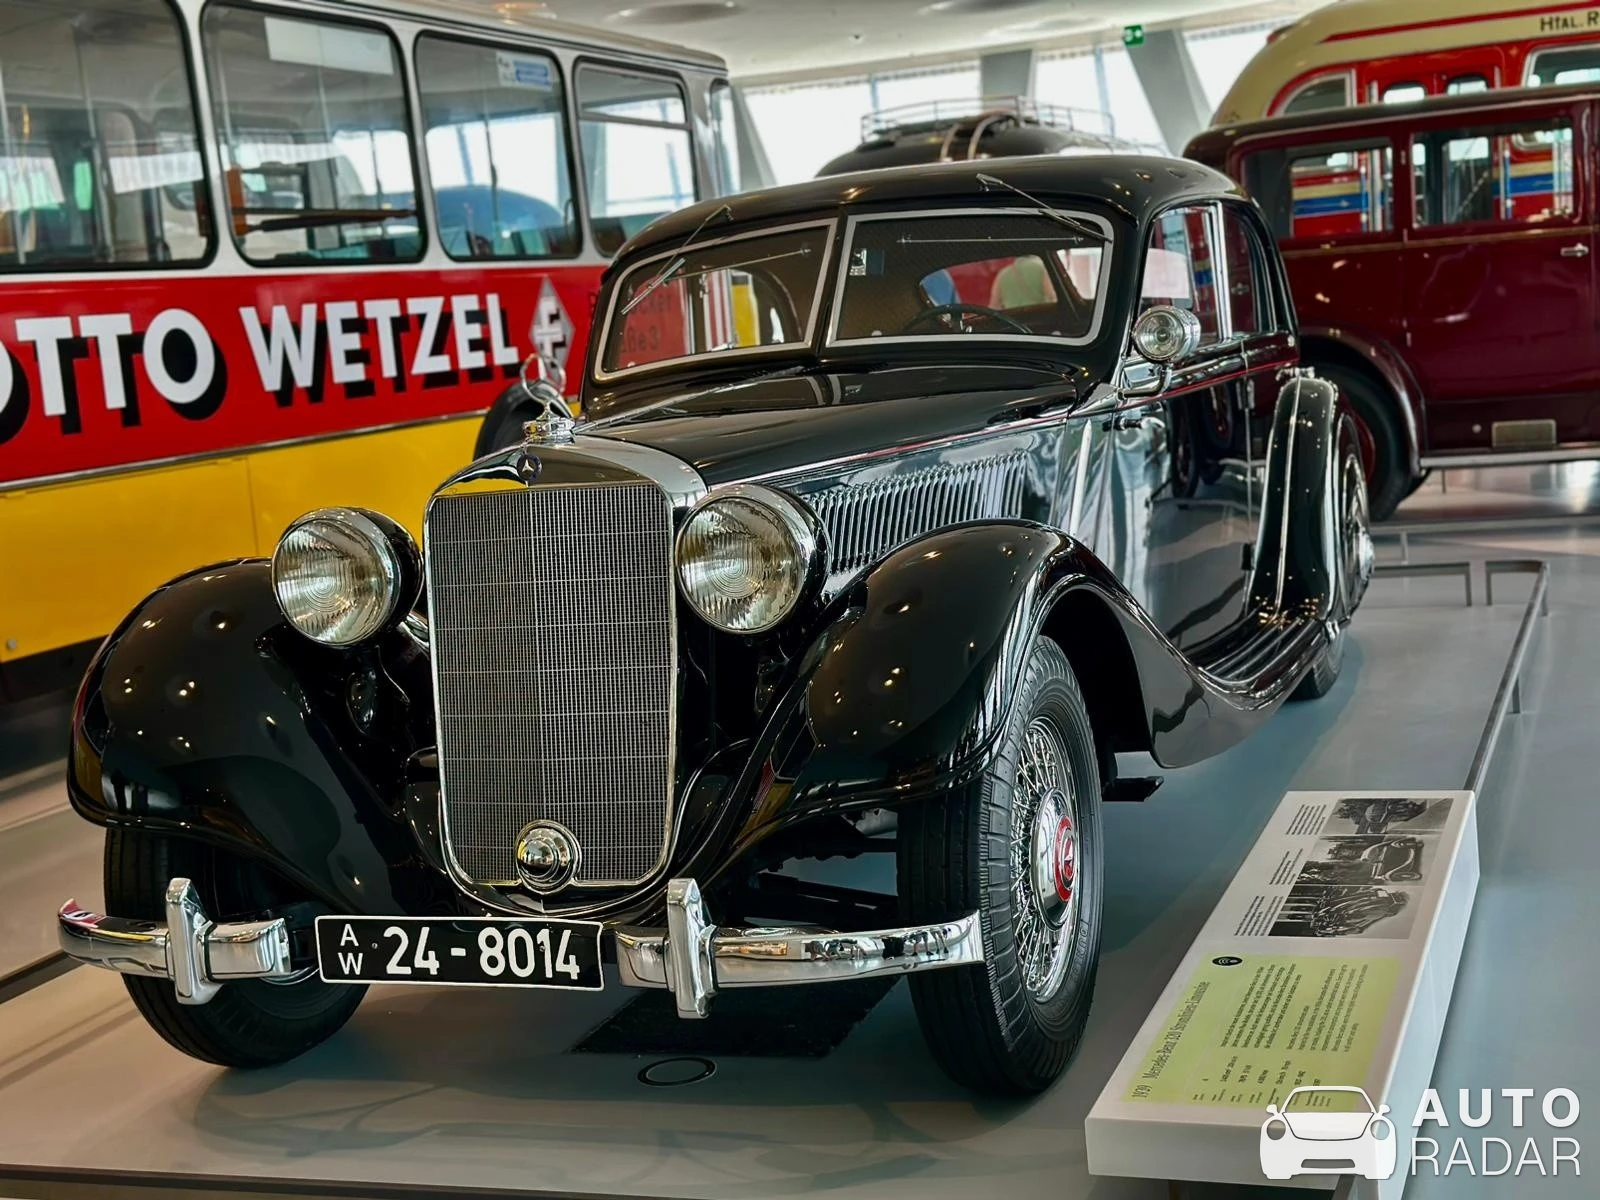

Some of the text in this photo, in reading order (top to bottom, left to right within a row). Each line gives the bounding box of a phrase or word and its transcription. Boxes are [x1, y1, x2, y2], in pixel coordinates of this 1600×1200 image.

[0, 293, 519, 417] TTO WETZEL
[340, 924, 359, 947] A
[338, 952, 363, 975] W
